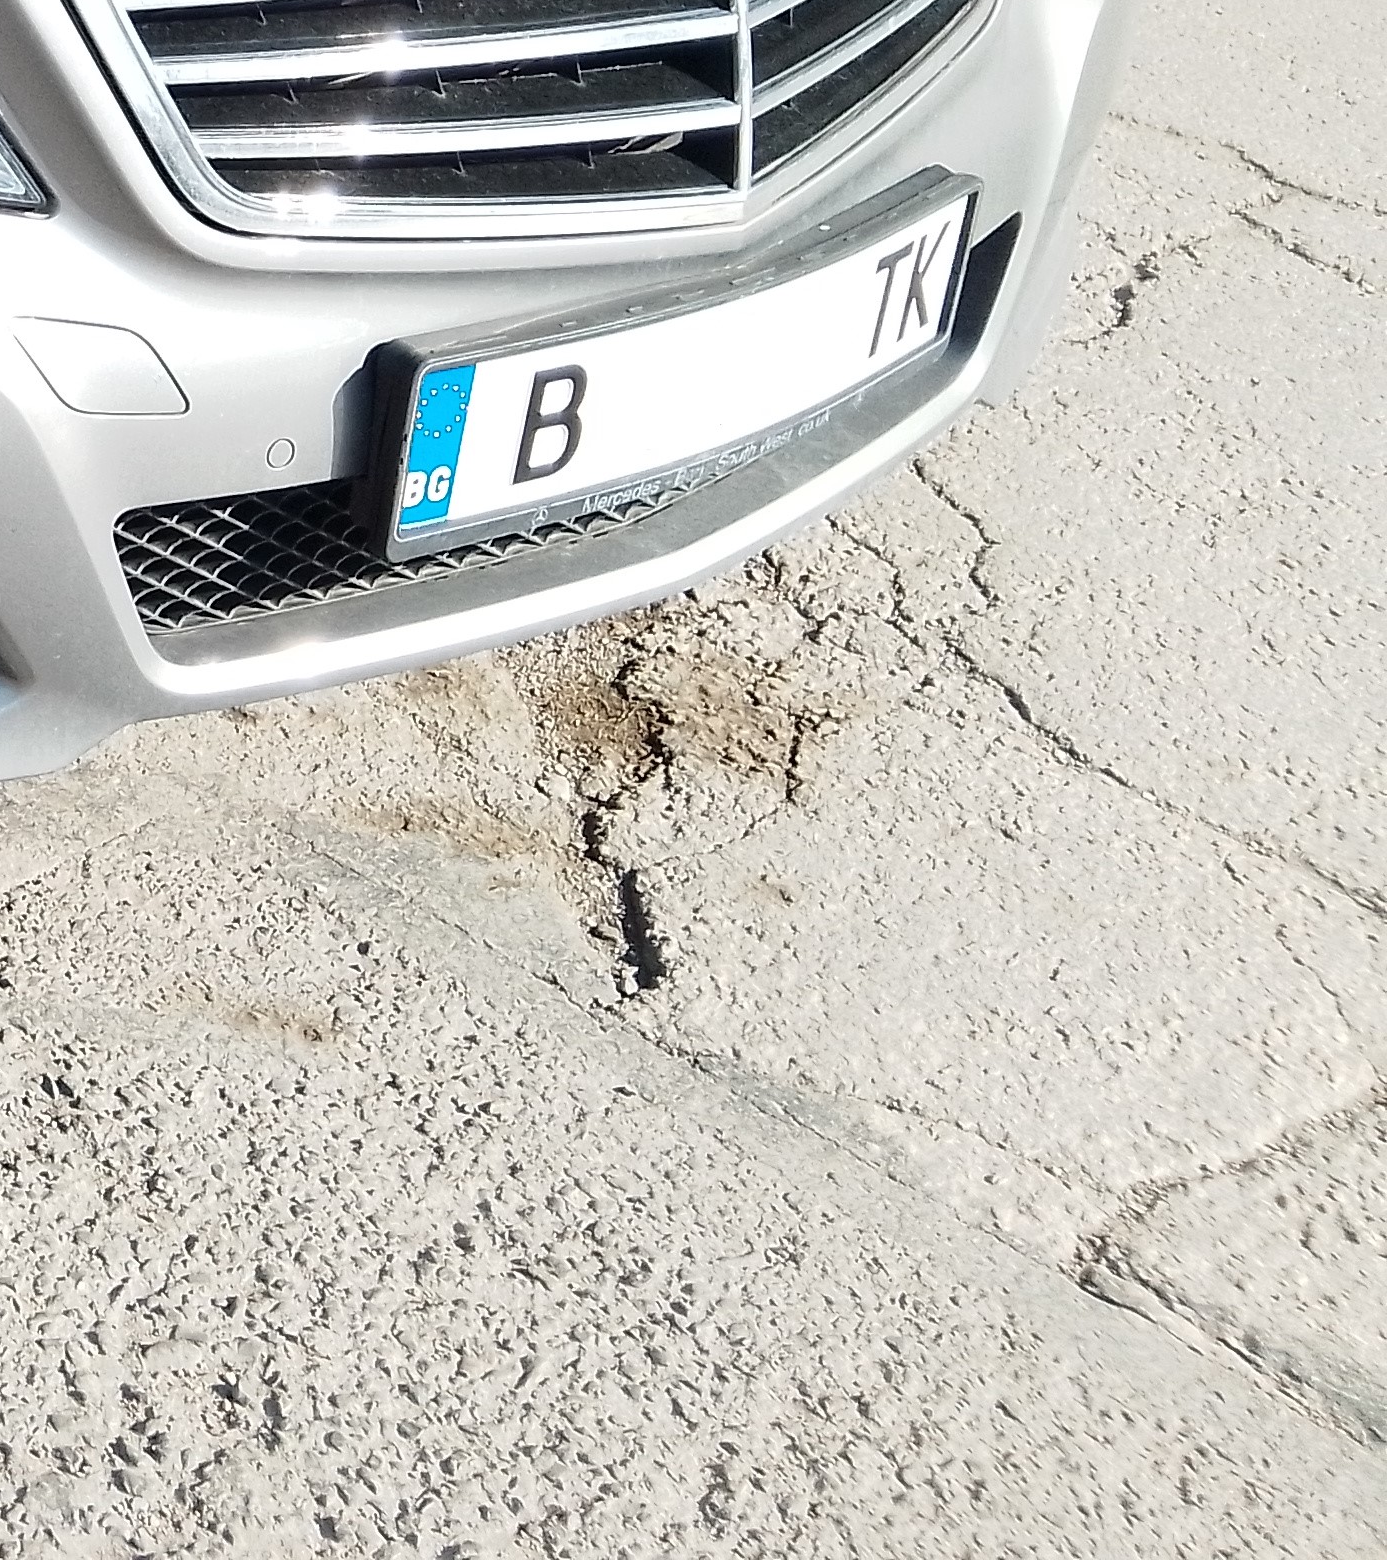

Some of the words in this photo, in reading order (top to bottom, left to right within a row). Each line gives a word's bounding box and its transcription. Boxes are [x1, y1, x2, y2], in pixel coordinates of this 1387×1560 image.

[513, 363, 587, 485] B
[868, 220, 951, 358] TK
[402, 465, 453, 508] BG
